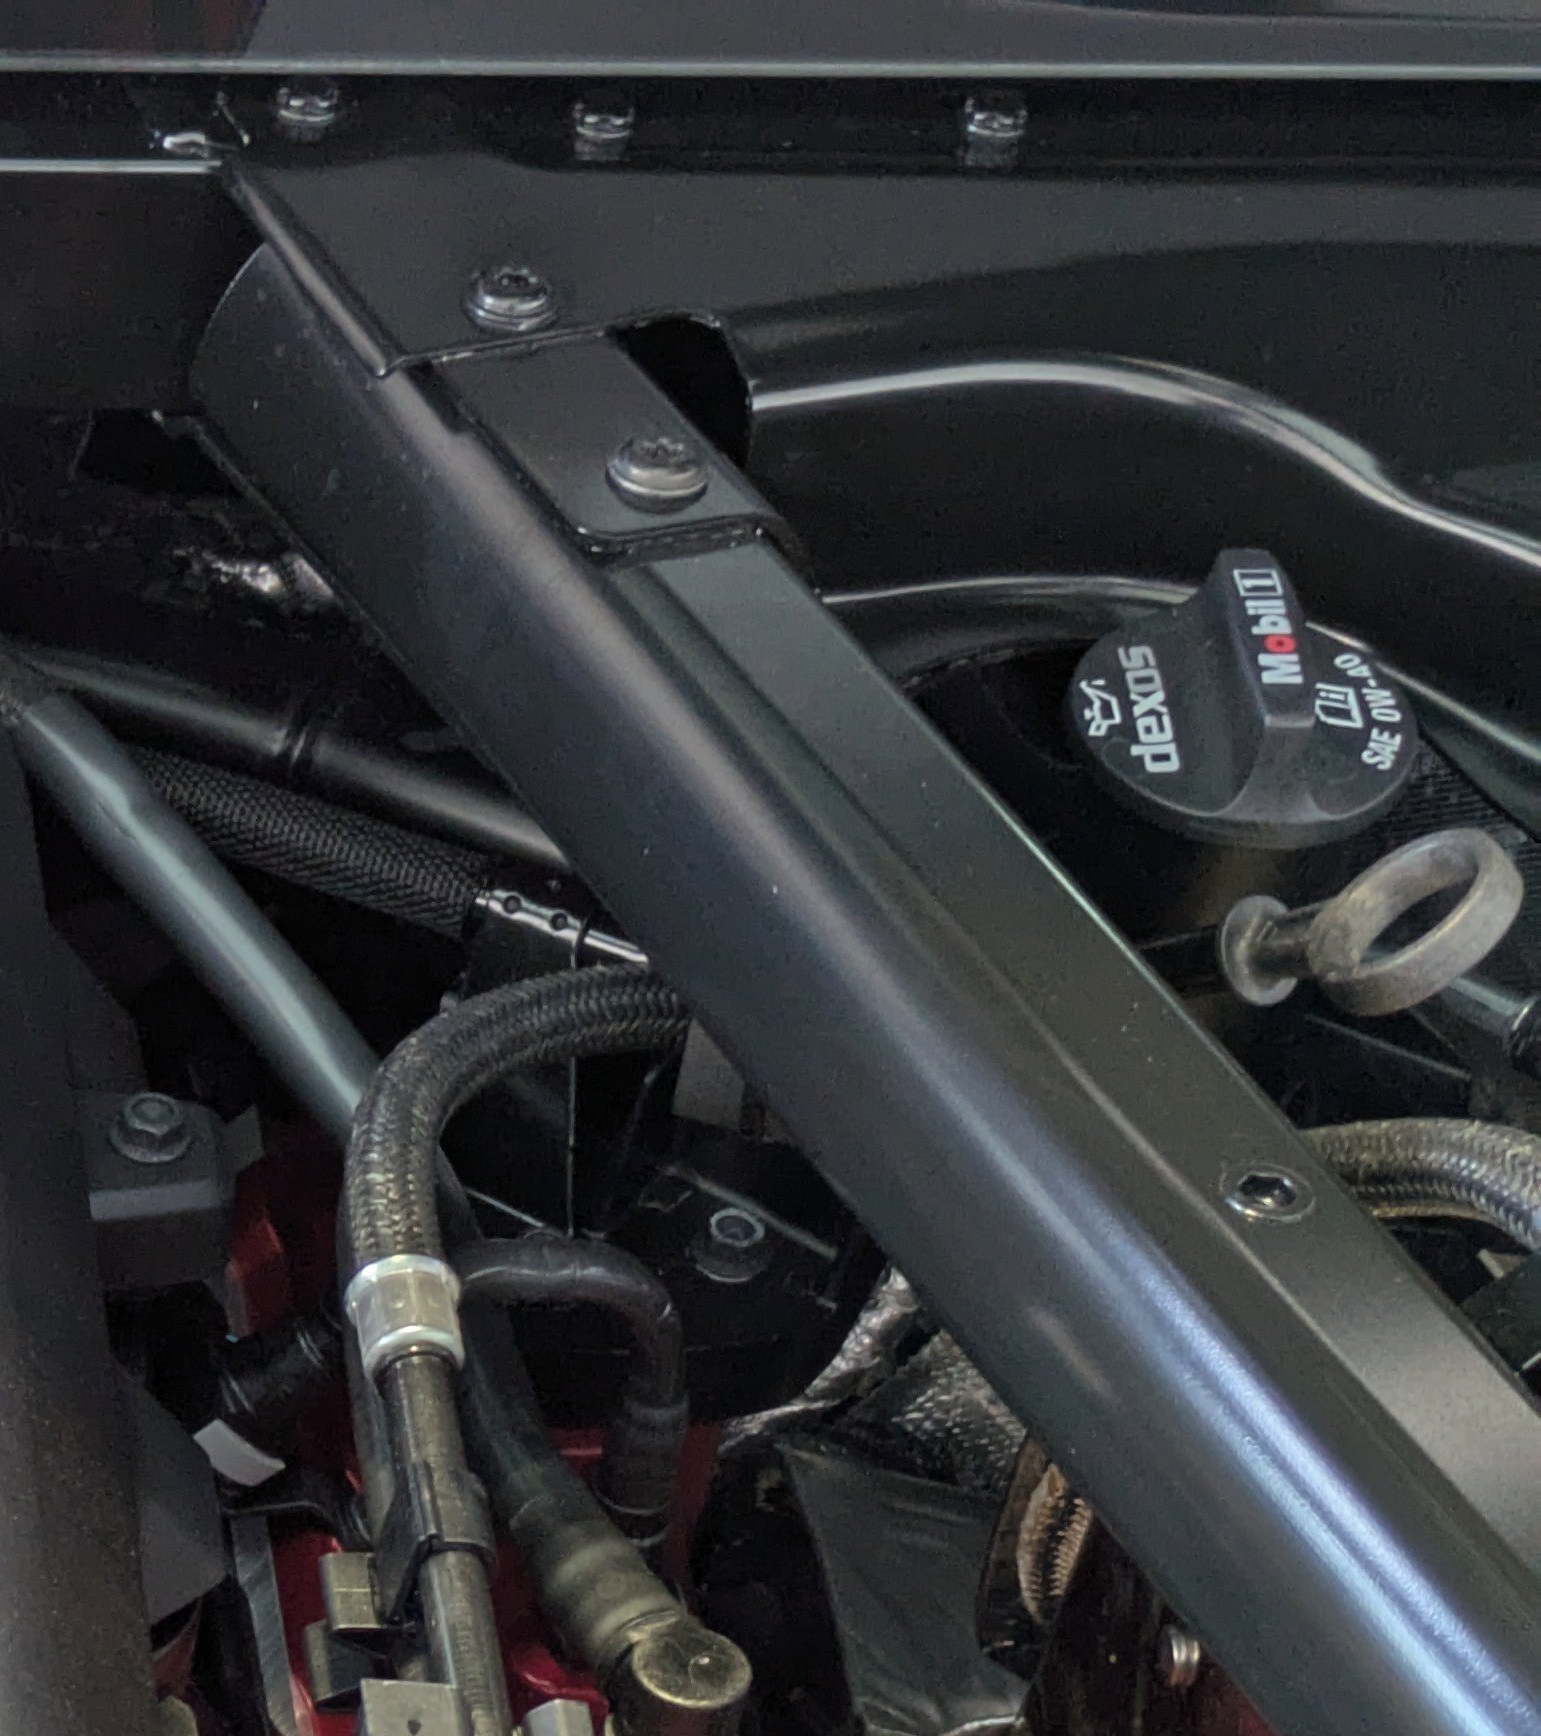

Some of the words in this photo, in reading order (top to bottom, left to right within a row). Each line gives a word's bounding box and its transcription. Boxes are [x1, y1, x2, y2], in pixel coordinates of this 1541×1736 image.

[1244, 600, 1303, 685] Mobil
[1117, 644, 1181, 774] dexos
[1333, 652, 1403, 724] 0W-40
[1360, 727, 1403, 771] SAE
